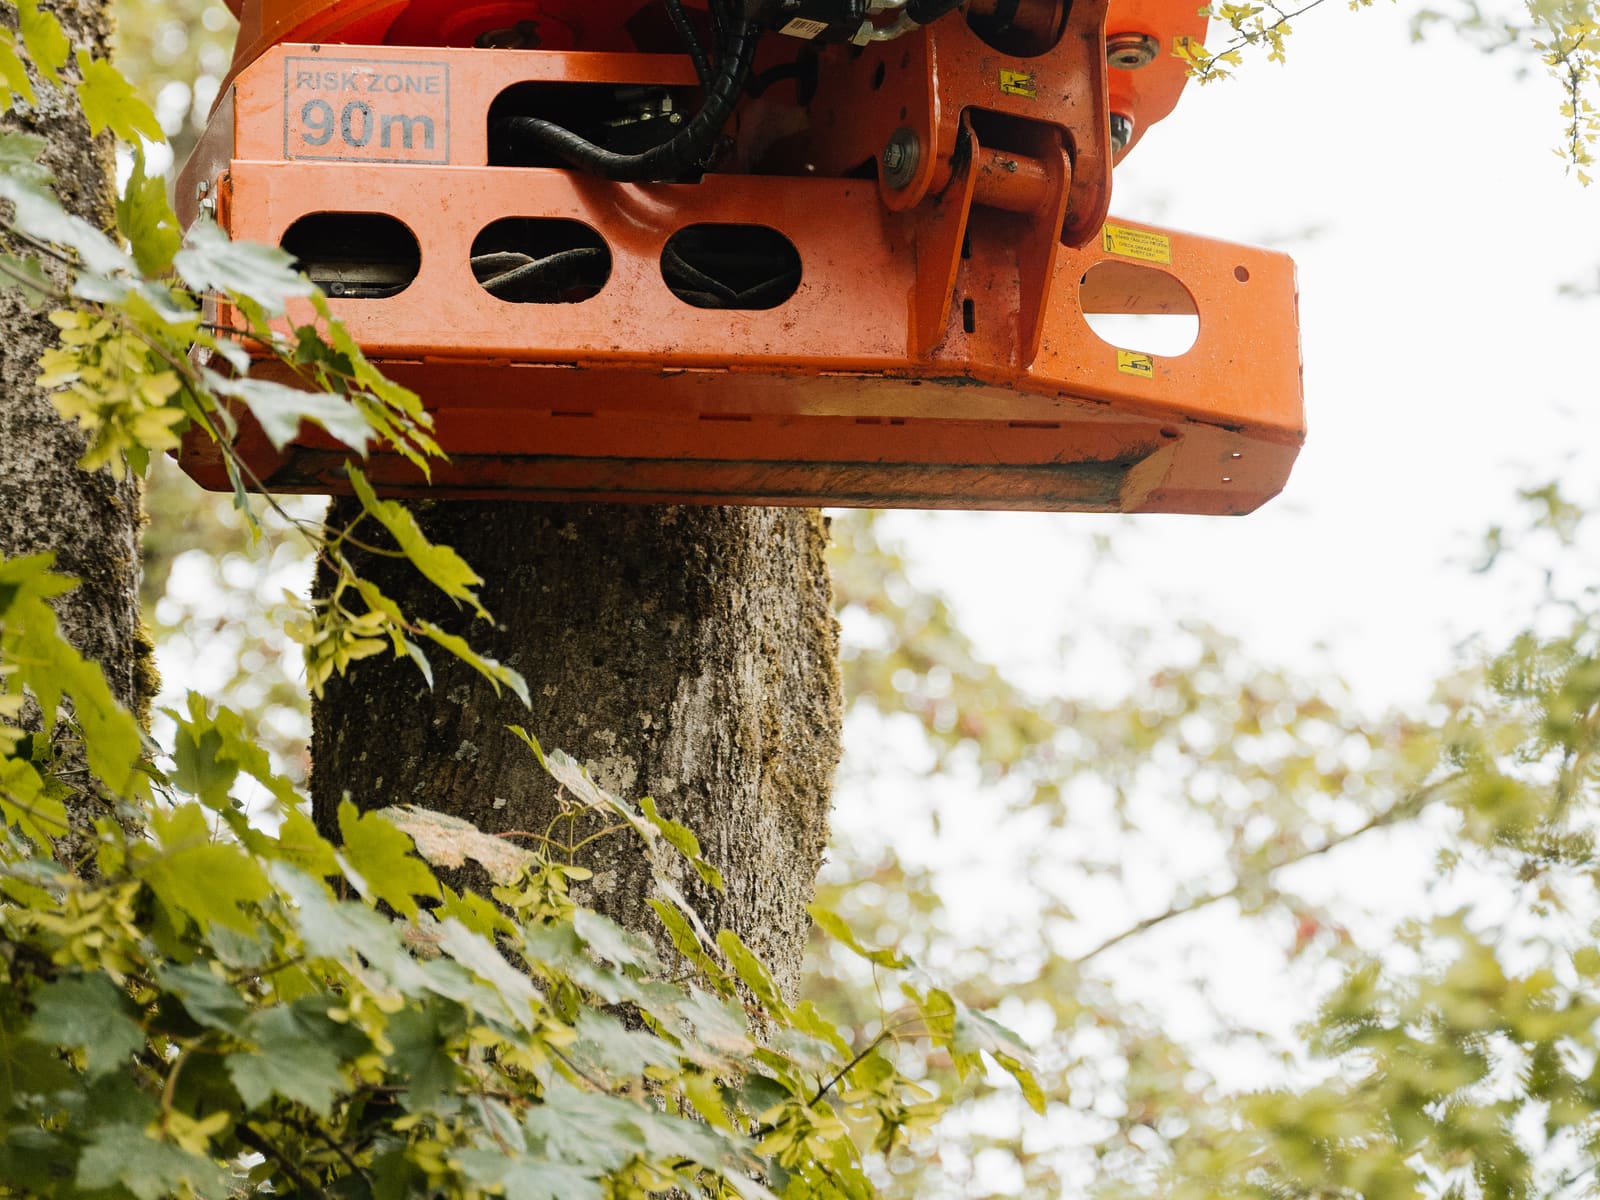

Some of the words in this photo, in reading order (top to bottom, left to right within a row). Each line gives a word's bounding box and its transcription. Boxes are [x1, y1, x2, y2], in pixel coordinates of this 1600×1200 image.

[296, 71, 359, 92] RISK
[367, 73, 441, 95] ZONE
[301, 98, 435, 150] 90m
